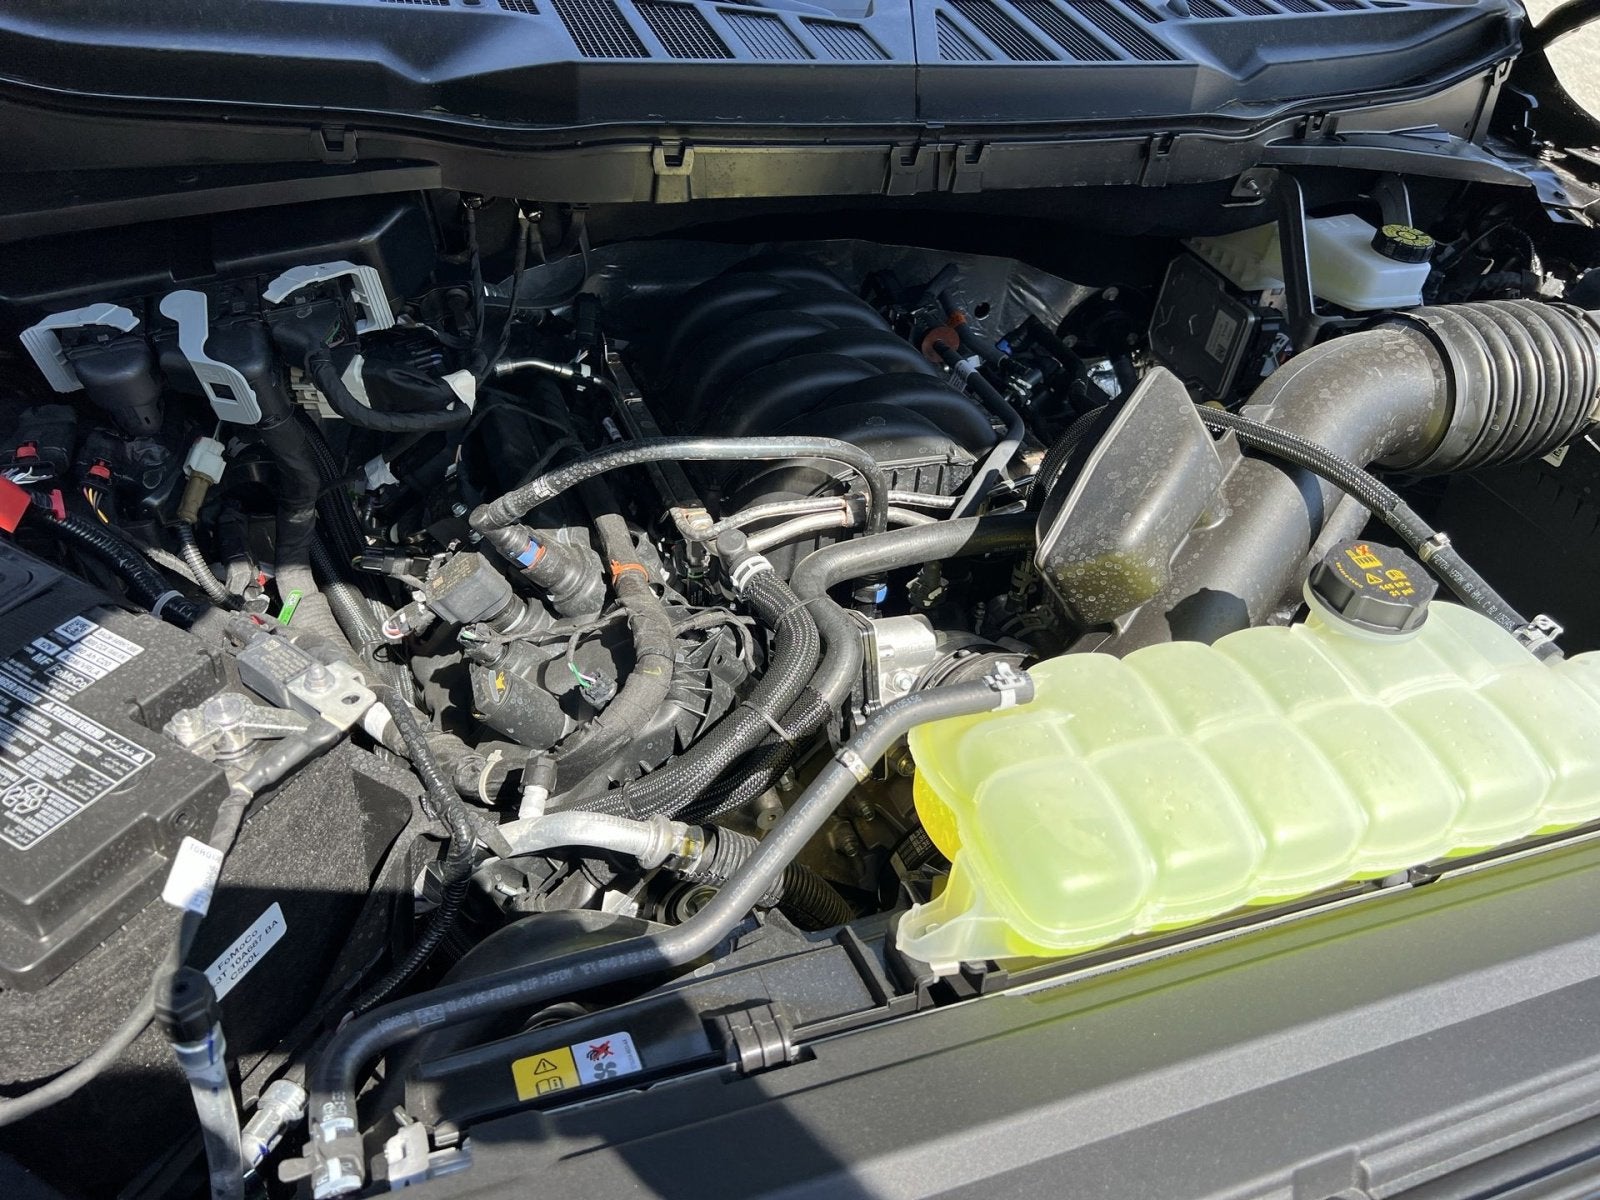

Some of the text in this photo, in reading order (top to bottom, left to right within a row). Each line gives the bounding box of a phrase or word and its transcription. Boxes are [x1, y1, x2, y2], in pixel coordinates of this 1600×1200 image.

[49, 664, 88, 688] FoMoCo
[214, 970, 227, 987] 3T
[264, 920, 278, 935] BA
[218, 930, 258, 970] FoMoCo
[230, 952, 260, 980] C500L
